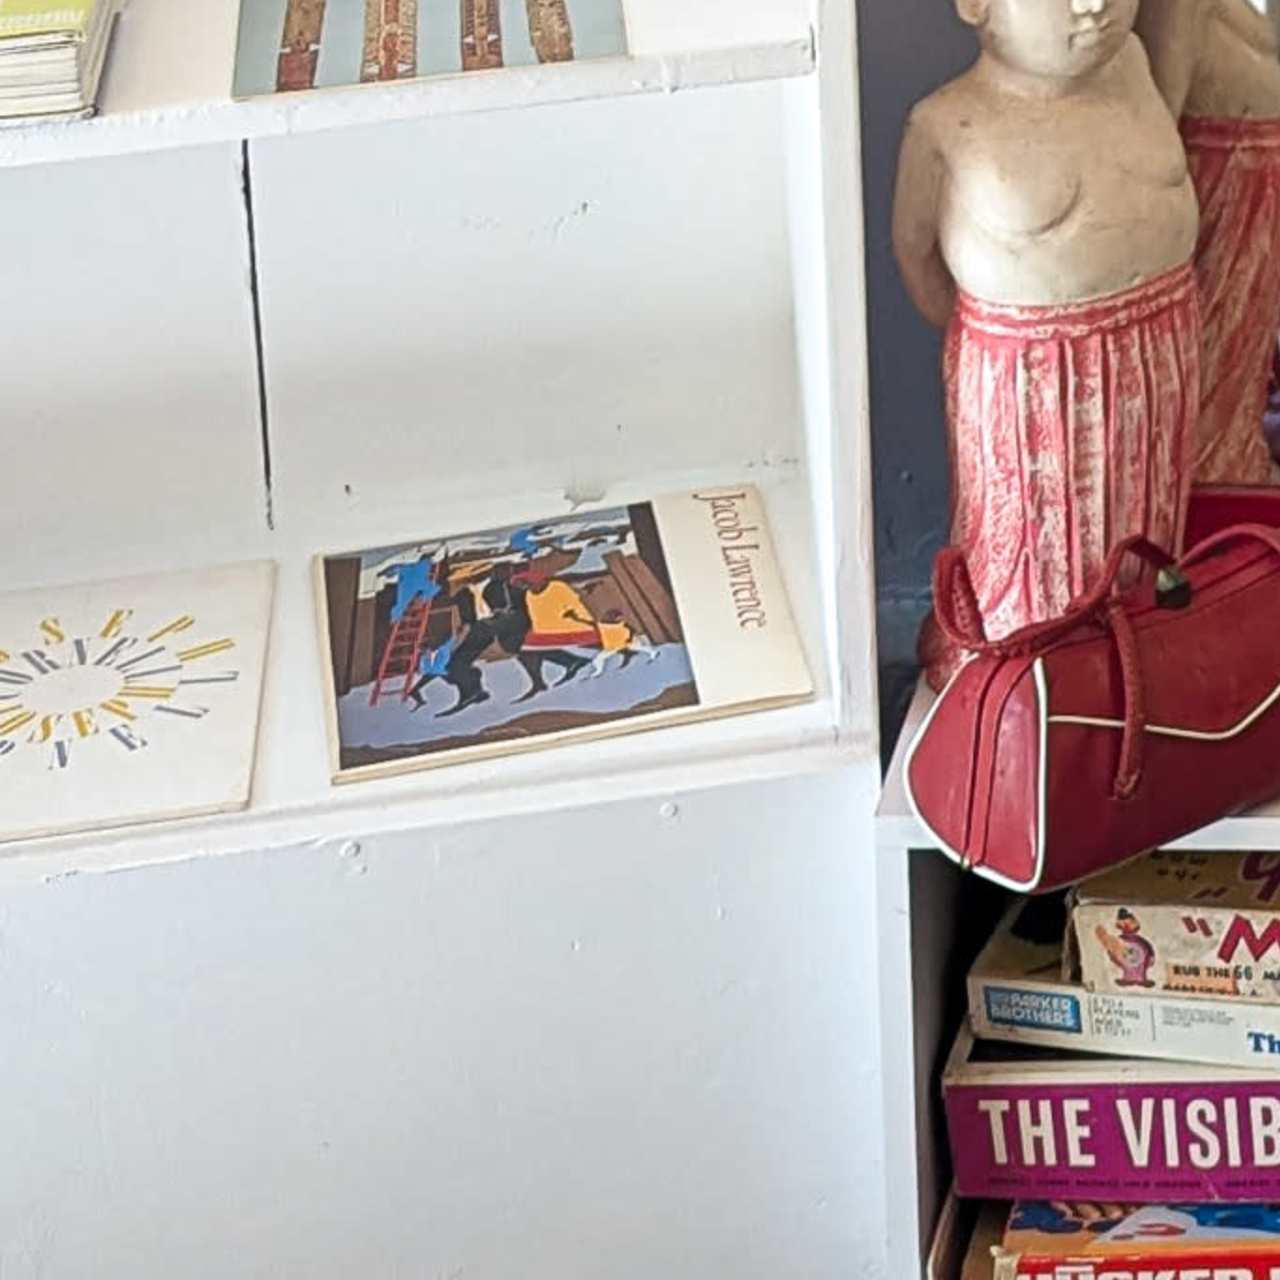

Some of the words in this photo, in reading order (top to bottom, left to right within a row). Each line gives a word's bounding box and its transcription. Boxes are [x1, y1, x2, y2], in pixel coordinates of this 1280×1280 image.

[692, 493, 758, 541] Jacob
[721, 544, 766, 628] Lawrence
[1173, 965, 1200, 977] RUB
[1205, 967, 1231, 978] THE
[990, 1006, 1074, 1027] BROTHERS
[1010, 993, 1072, 1011] PARKER
[978, 1097, 1096, 1168] THE
